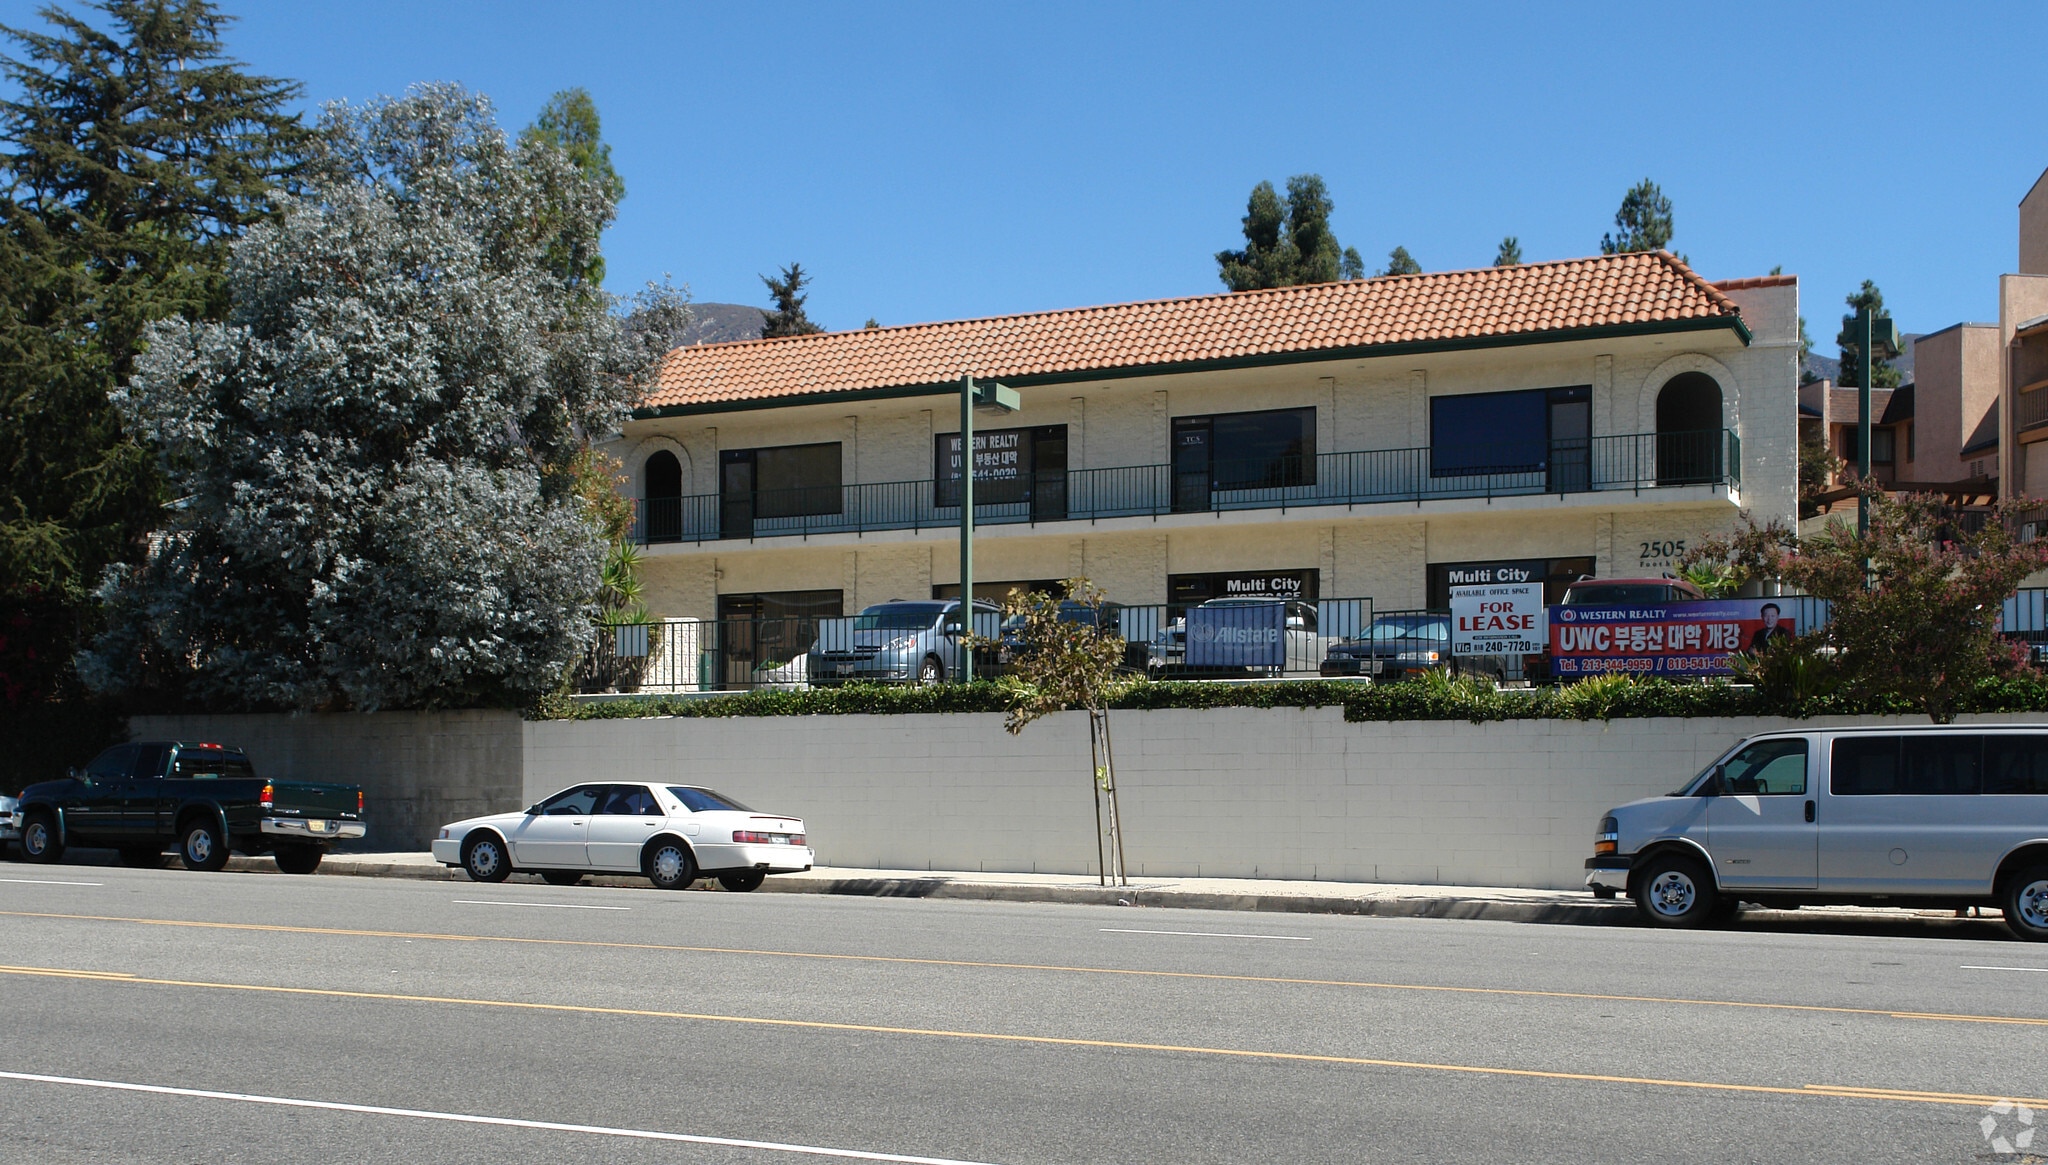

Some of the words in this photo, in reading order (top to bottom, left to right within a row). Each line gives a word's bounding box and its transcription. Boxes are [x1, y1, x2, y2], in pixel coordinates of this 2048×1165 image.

[950, 436, 987, 451] WEERN
[989, 434, 1019, 449] REALTY
[975, 452, 1000, 467] 부동산
[1640, 540, 1685, 558] 2505
[1449, 569, 1491, 583] Multi
[1496, 568, 1530, 581] City
[1227, 579, 1266, 592] Multi
[1270, 578, 1301, 591] City
[1456, 589, 1486, 597] AVAILABLE
[1480, 602, 1514, 613] FOR
[1580, 611, 1626, 620] WESTERN
[1629, 609, 1667, 619] REALTY
[1459, 615, 1535, 631] LEASE
[1213, 627, 1278, 643] Allstate
[1560, 626, 1611, 651] UWC
[1614, 625, 1664, 652] 부동산
[1667, 624, 1703, 650] 대학
[1706, 623, 1741, 649] 개강
[1485, 641, 1531, 653] 240-7720
[1559, 658, 1578, 672] Tel.
[1581, 658, 1653, 672] 213-344-9959
[1656, 658, 1664, 671] /
